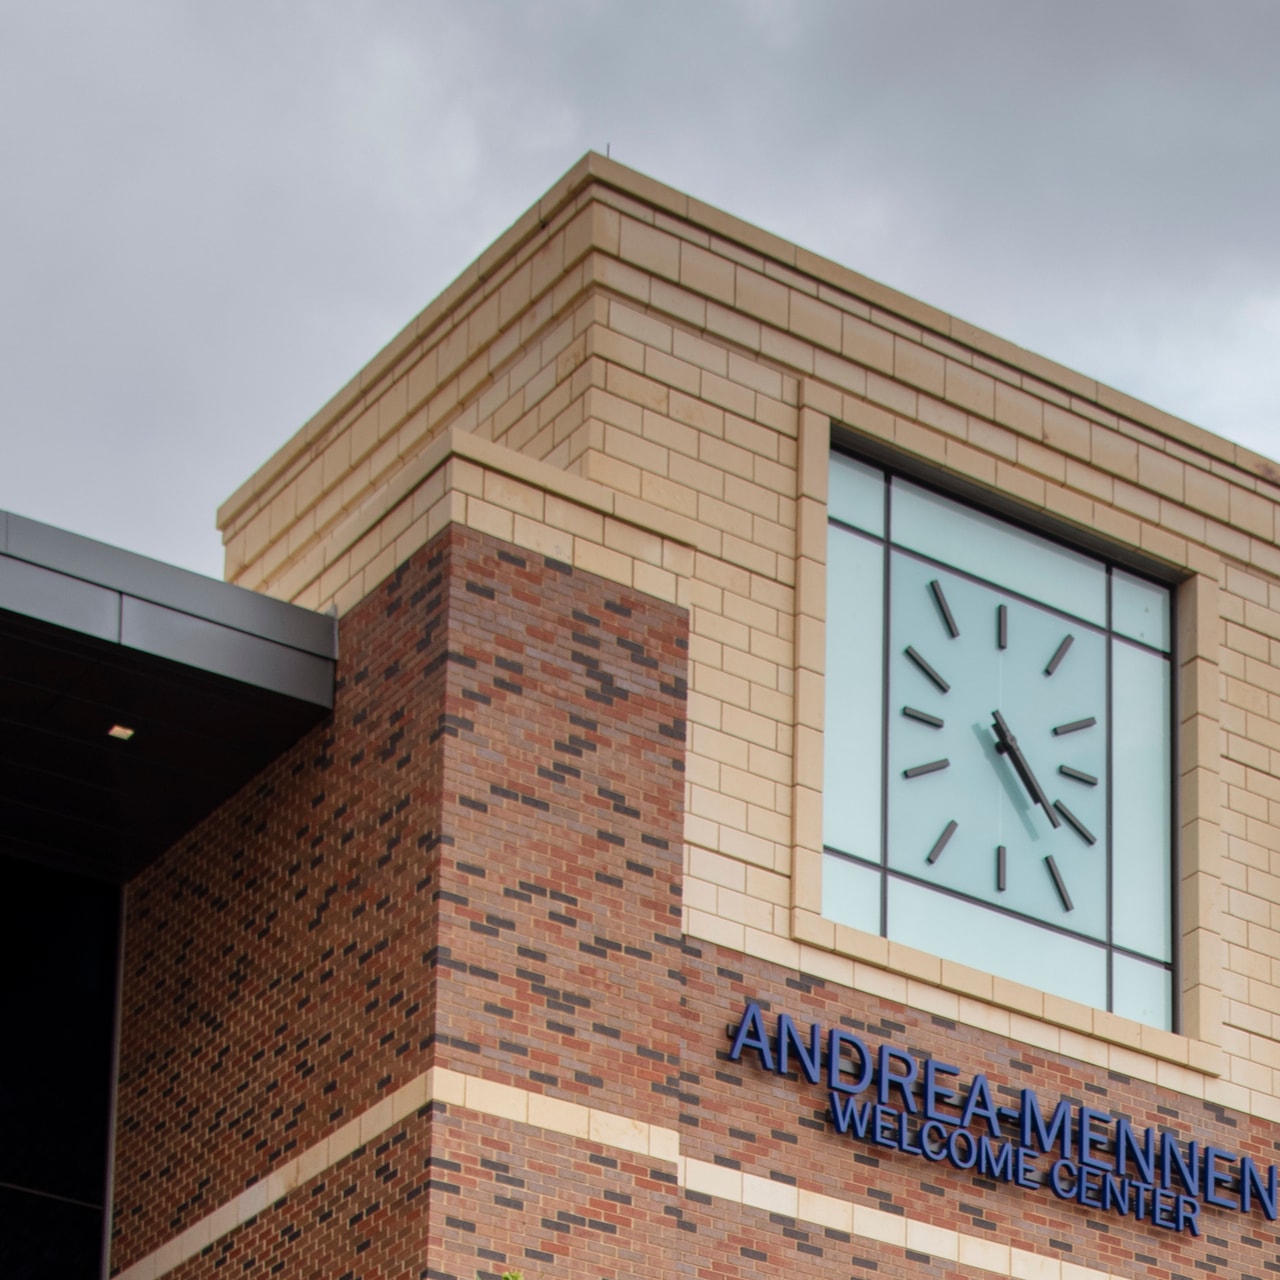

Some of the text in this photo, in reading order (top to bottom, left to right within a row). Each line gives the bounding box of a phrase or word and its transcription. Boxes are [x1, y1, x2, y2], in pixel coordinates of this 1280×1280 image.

[729, 1003, 1278, 1221] ANDREA-MENNEN
[829, 1091, 1201, 1236] WELCOME CENTER
